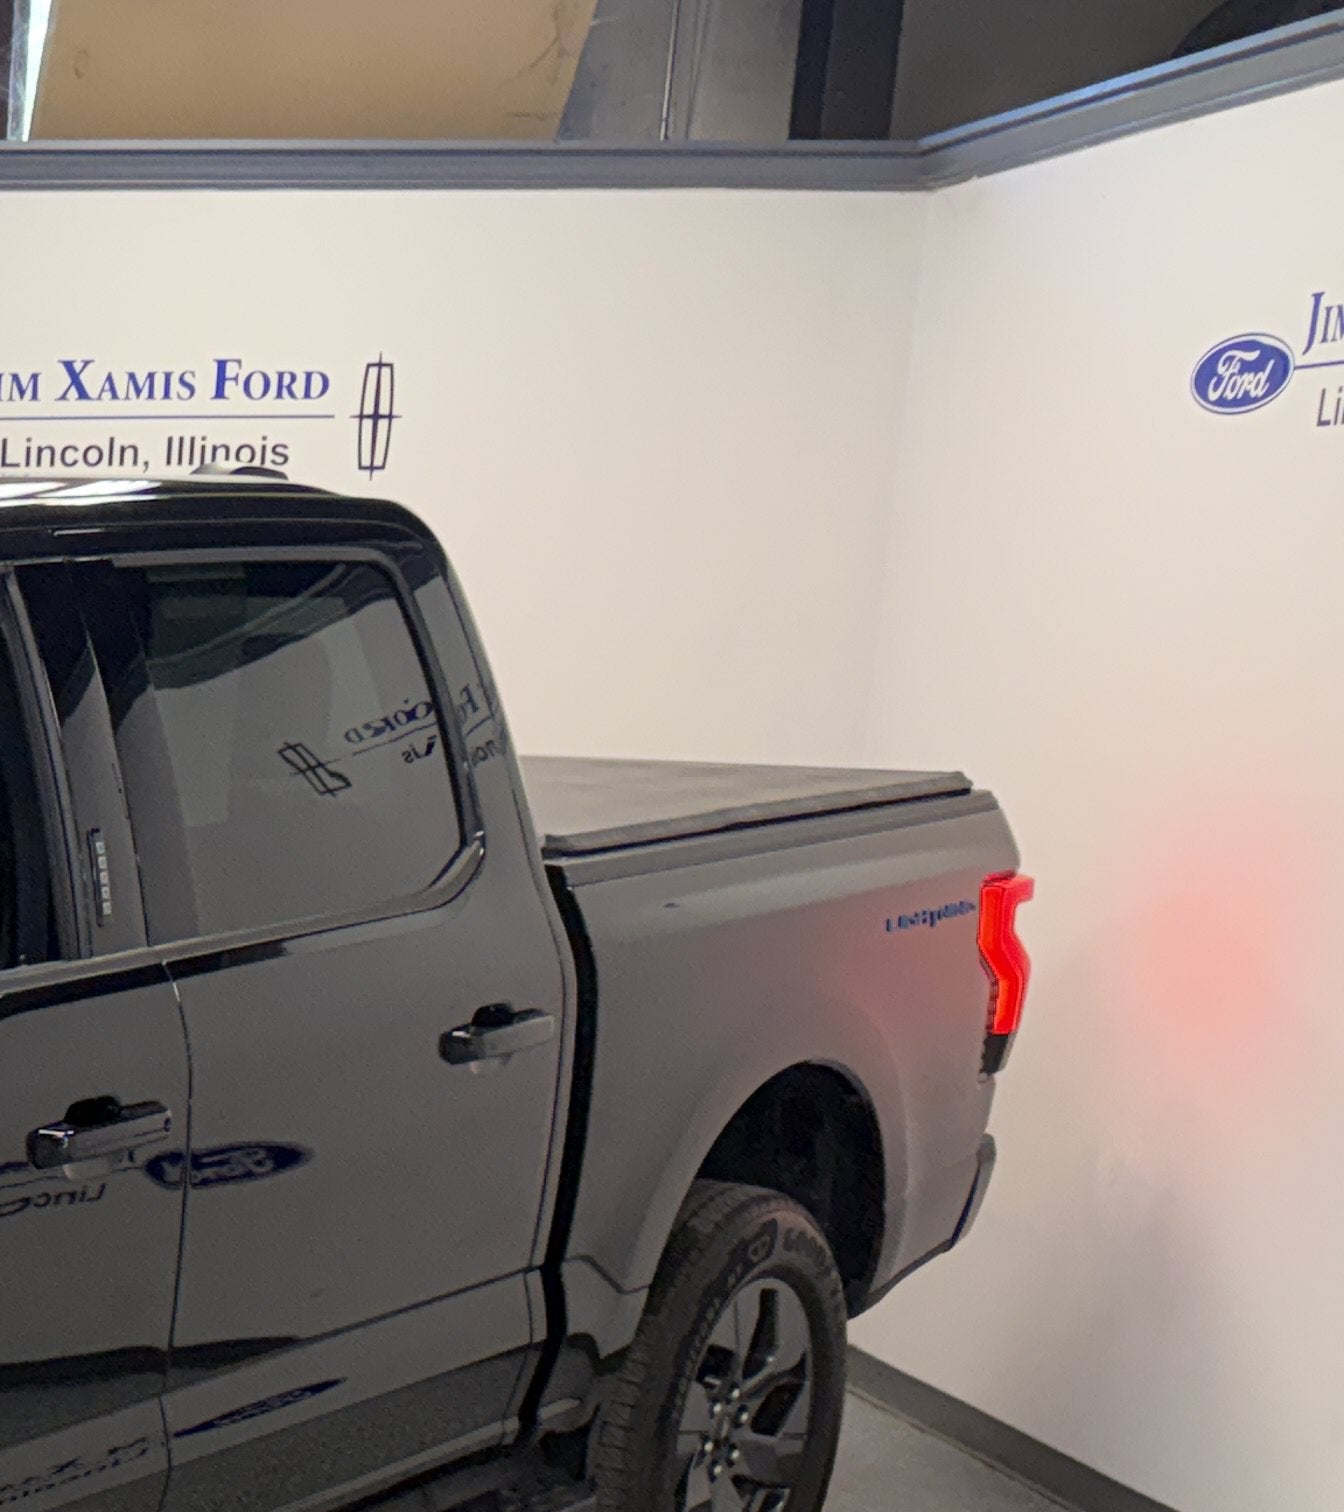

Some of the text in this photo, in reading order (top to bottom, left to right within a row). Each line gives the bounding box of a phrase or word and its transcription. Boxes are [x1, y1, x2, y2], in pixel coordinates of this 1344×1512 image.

[56, 359, 196, 401] XAMIS
[210, 359, 330, 400] FORD
[1207, 349, 1276, 402] Ford
[0, 435, 290, 474] Lincoln, Illinois
